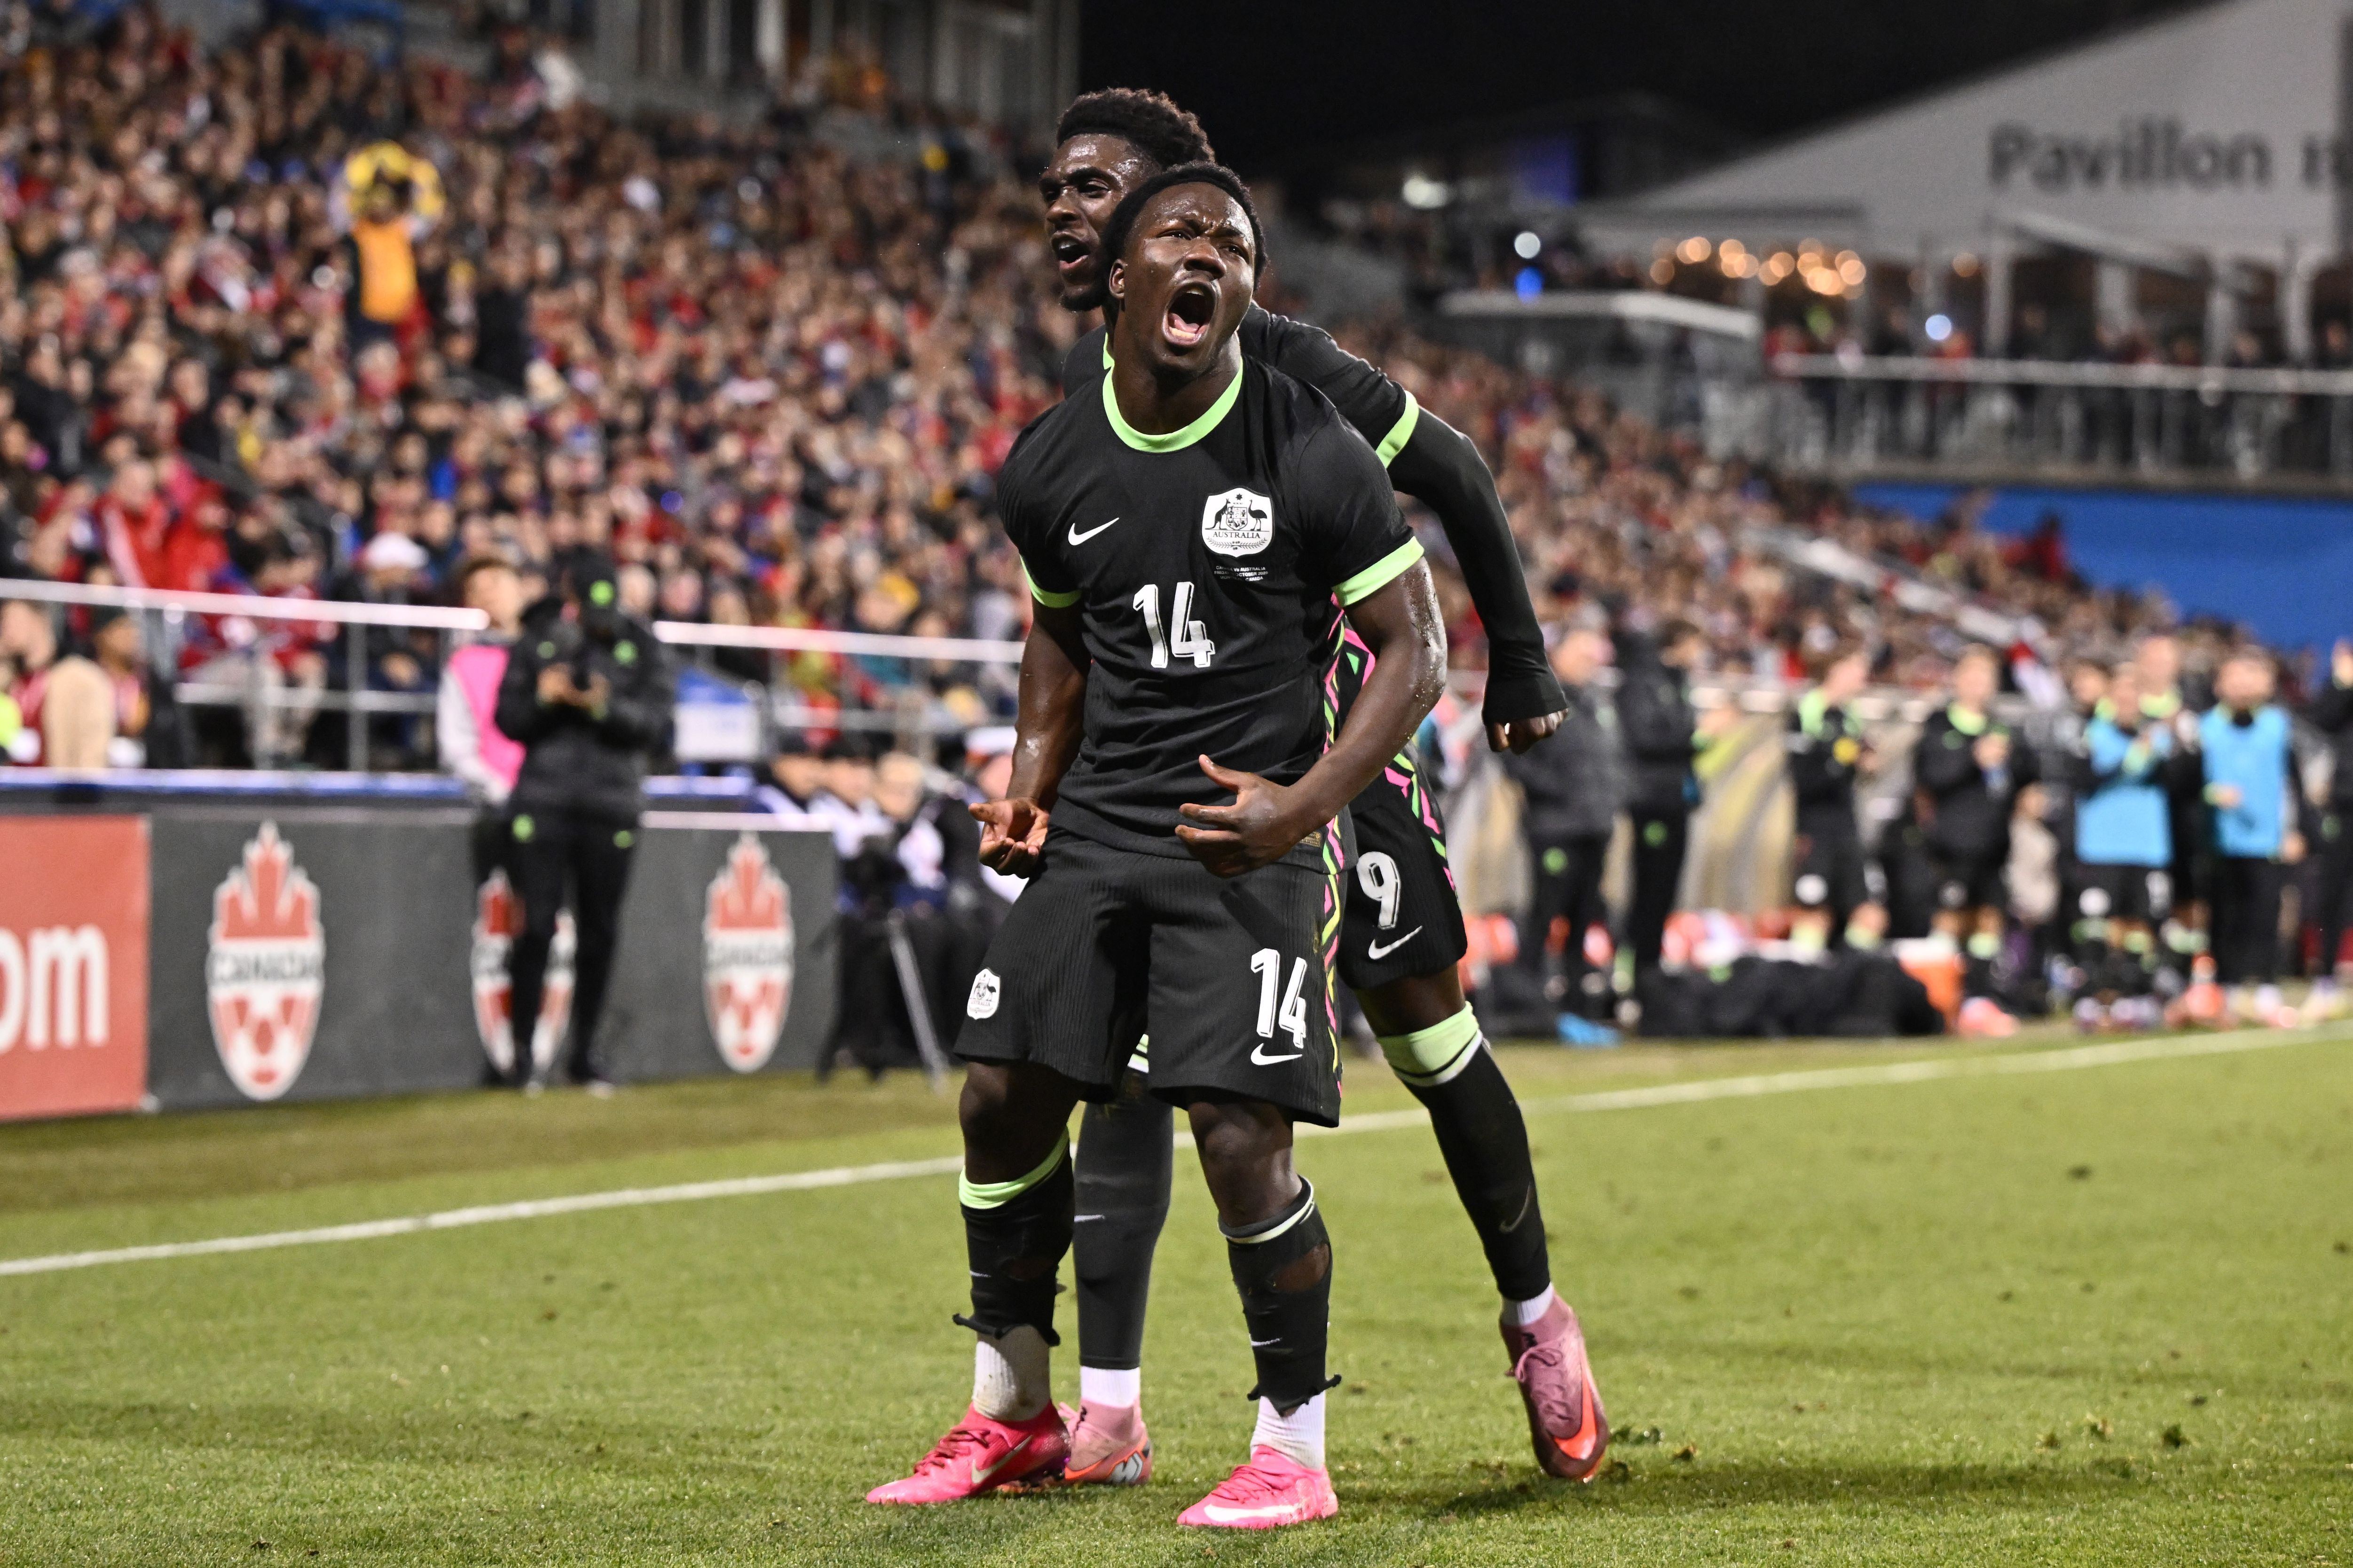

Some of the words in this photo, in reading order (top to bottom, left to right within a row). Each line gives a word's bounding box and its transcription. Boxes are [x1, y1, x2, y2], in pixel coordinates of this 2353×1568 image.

[1987, 118, 2272, 189] Pavillon
[1133, 581, 1216, 668] 14
[1357, 851, 1401, 930] 9
[1251, 948, 1307, 1049] 14
